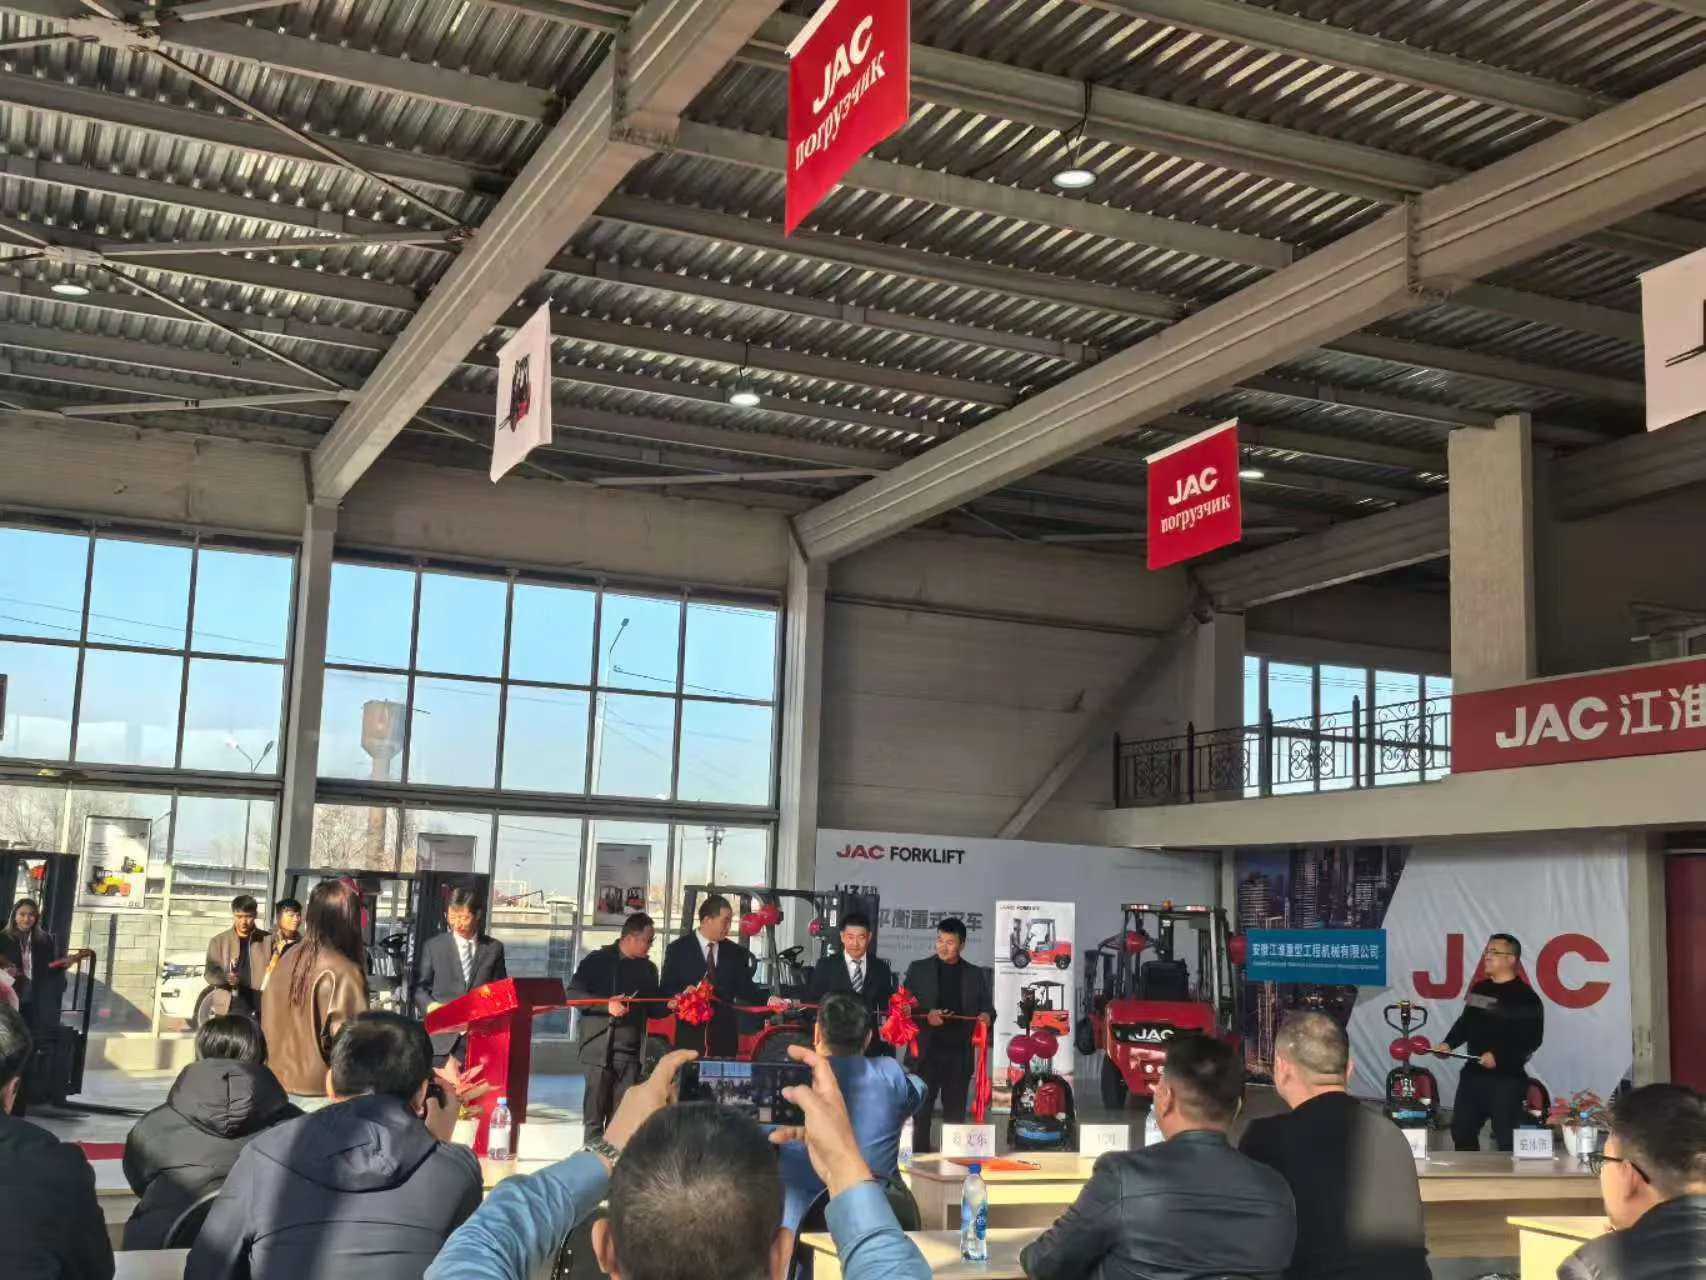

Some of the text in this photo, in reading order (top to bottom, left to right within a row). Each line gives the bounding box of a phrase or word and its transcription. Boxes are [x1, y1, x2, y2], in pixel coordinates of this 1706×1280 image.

[812, 15, 873, 114] JAC
[795, 50, 885, 171] погрузчик
[1168, 467, 1218, 506] JAC
[1160, 494, 1231, 533] погрузчик
[1495, 696, 1609, 749] JAC
[1618, 683, 1706, 736] 江淮
[836, 844, 965, 864] JAC FORKLIFT
[1252, 943, 1379, 960] 安徽江淮重型工程机械有限公司
